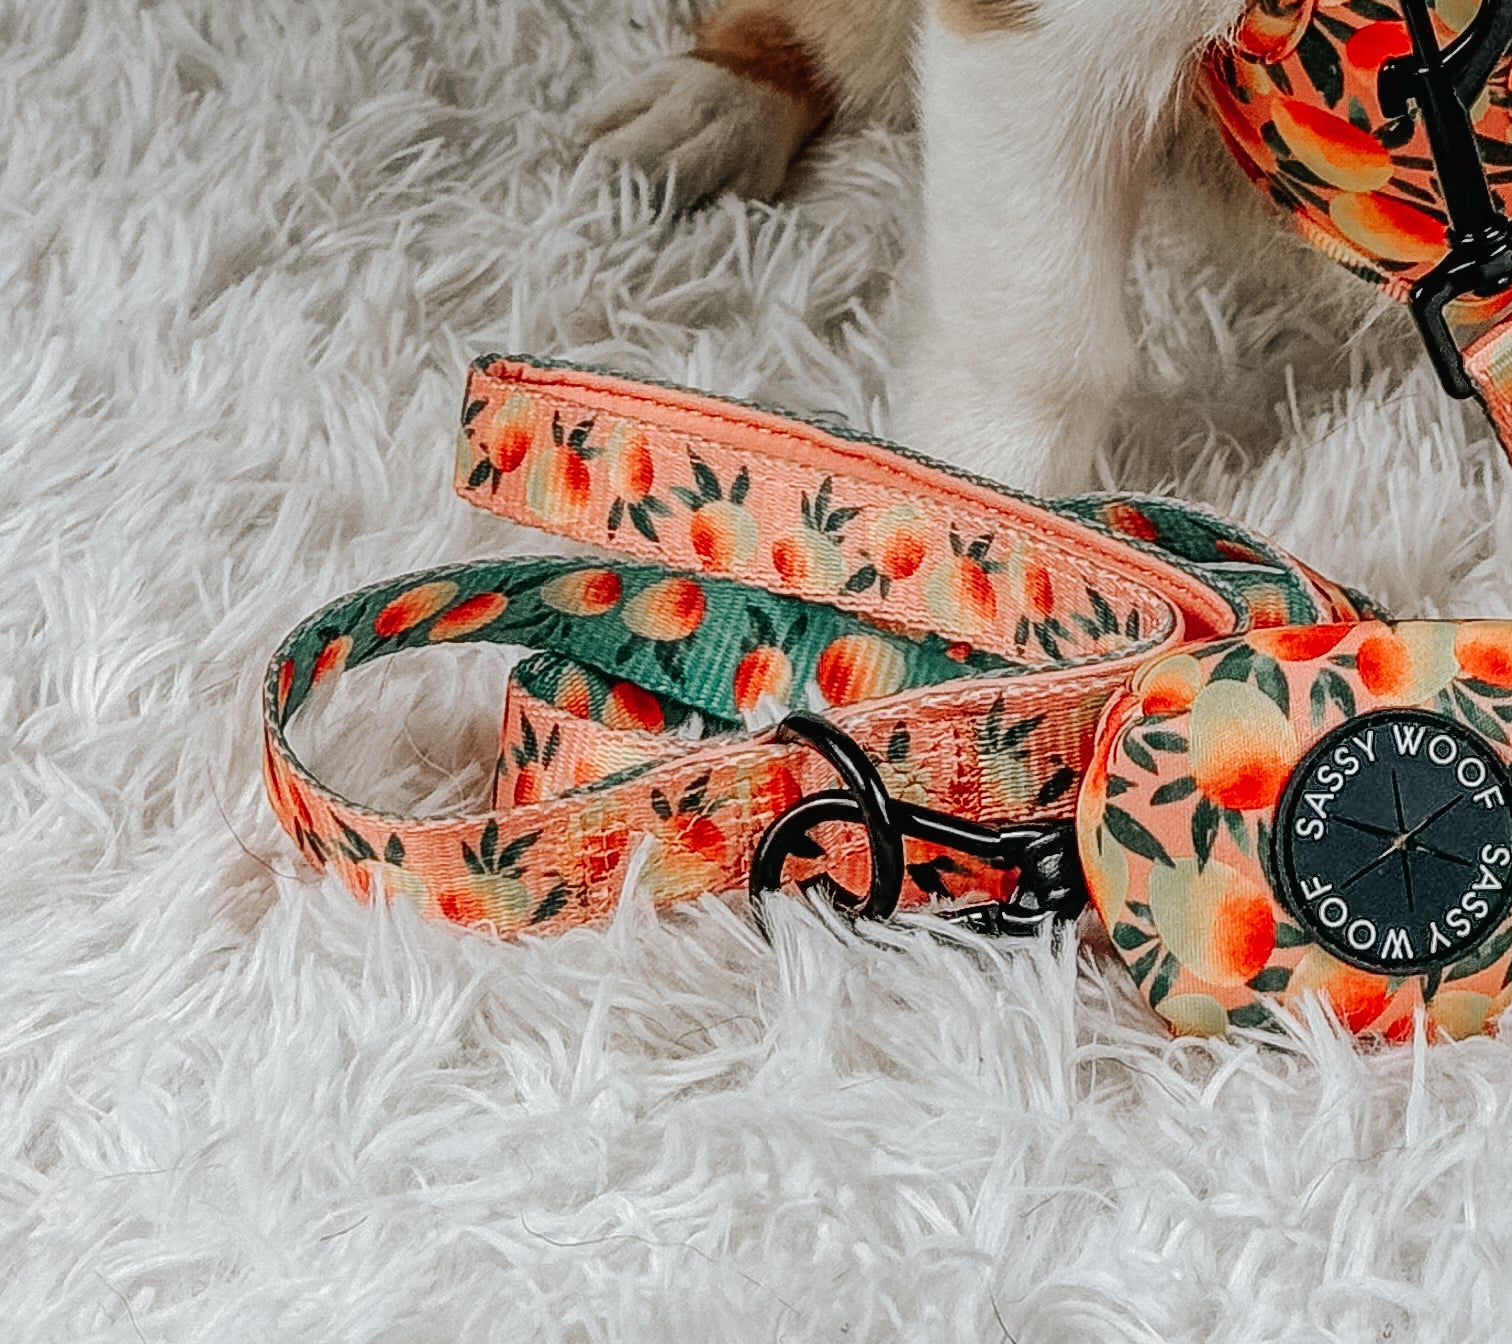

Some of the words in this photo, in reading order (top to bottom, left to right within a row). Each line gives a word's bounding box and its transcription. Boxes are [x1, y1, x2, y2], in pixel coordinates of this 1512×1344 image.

[1295, 730, 1376, 841] SASSY
[1393, 724, 1505, 810] WOOF
[1300, 876, 1414, 960] WOOF
[1429, 843, 1511, 954] SASSY
